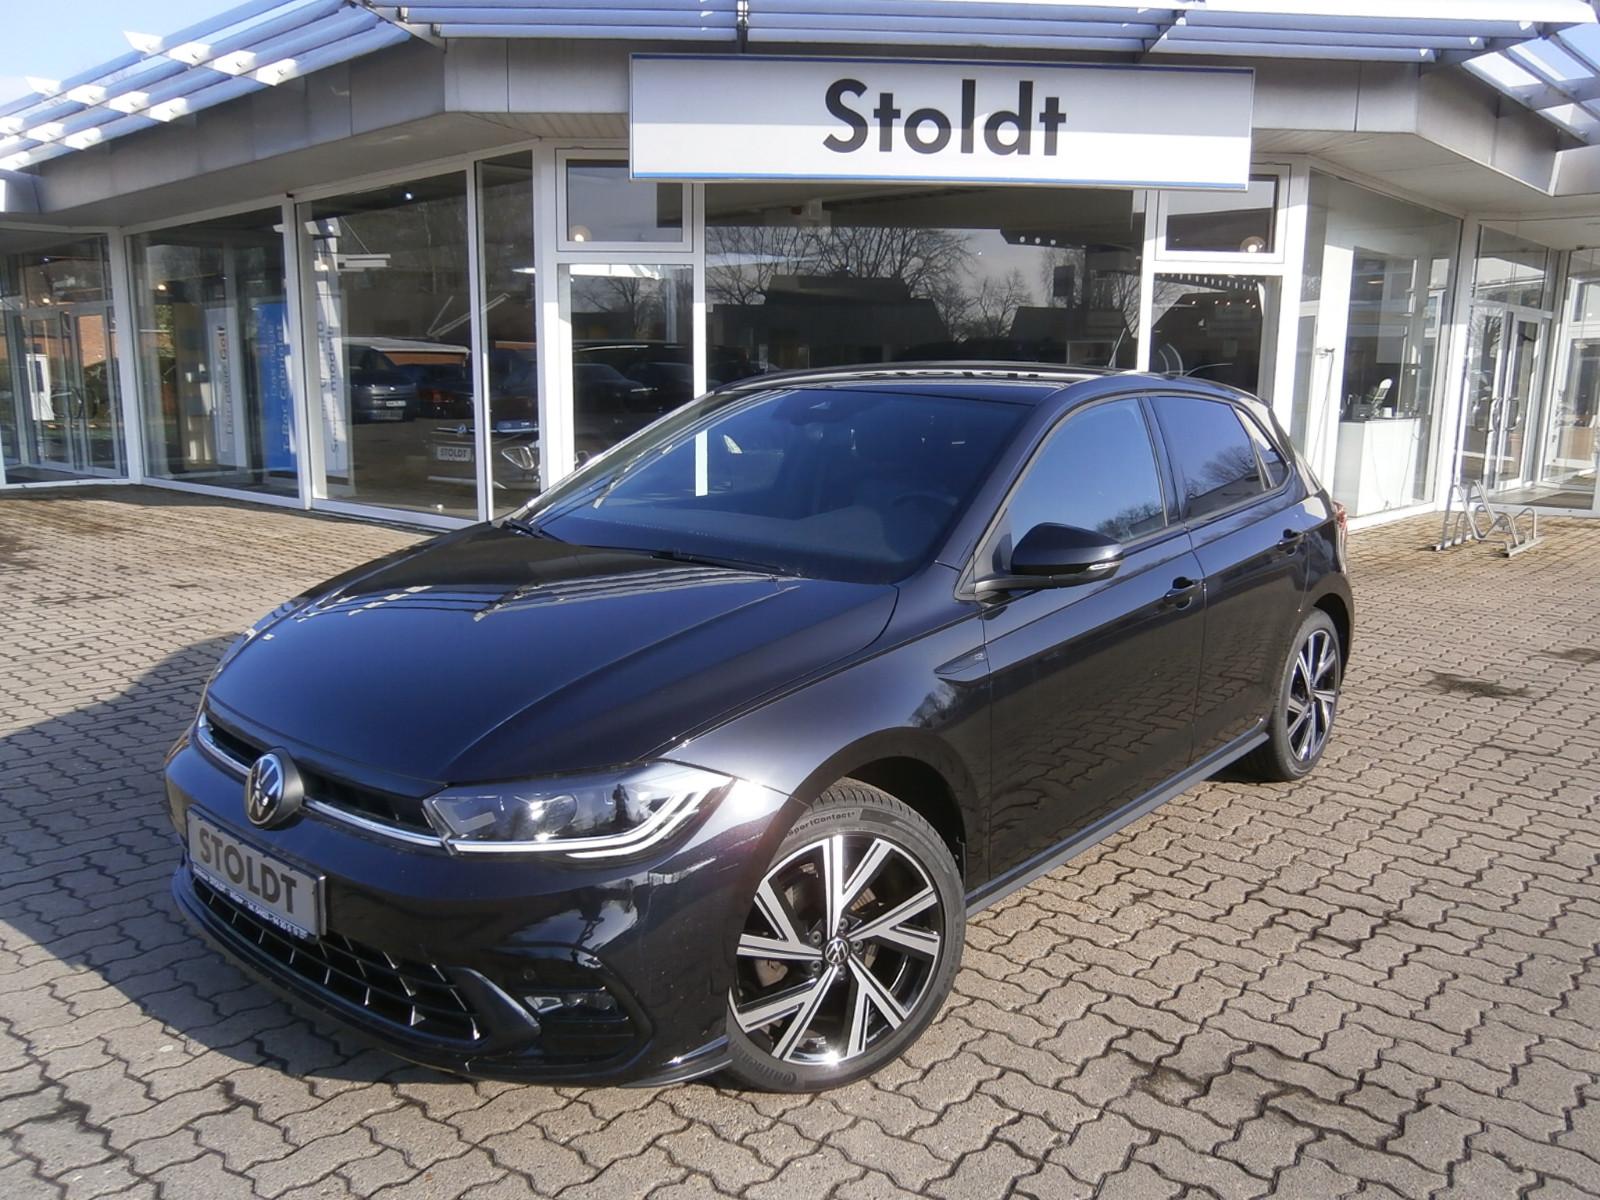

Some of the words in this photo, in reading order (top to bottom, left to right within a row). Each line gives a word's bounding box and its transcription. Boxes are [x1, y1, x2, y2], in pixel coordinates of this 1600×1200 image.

[822, 78, 1067, 156] Stoldt
[277, 324, 287, 401] Cabriolet
[199, 828, 297, 914] STOLDT
